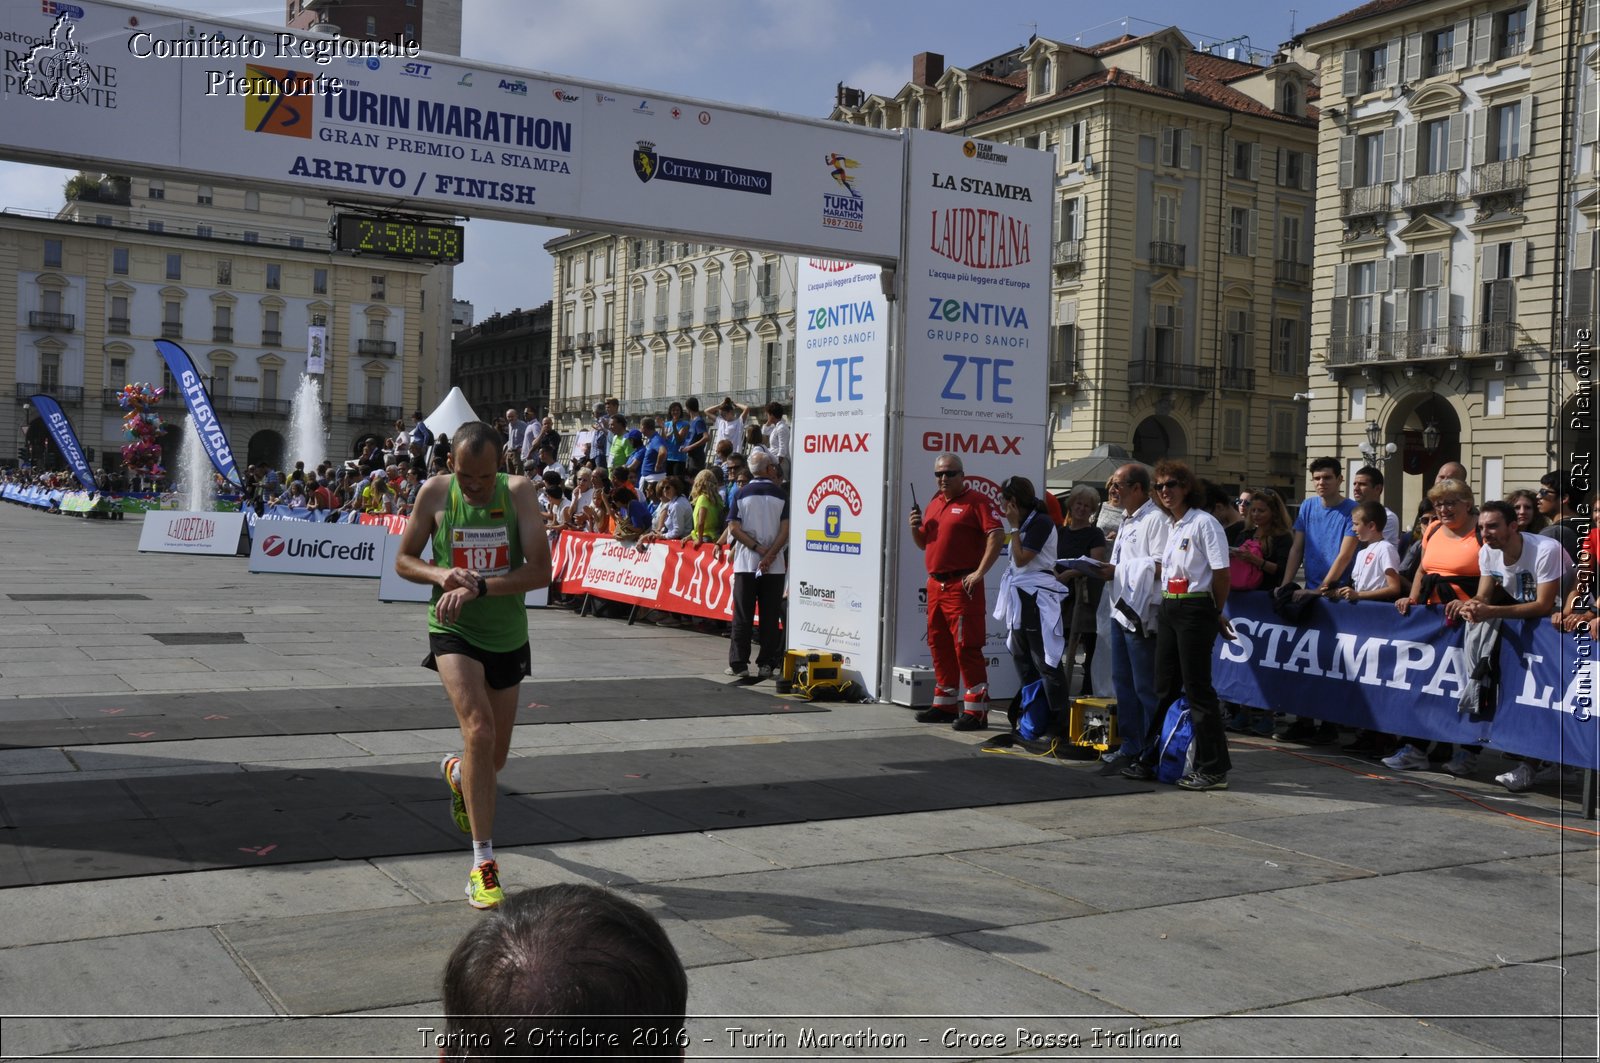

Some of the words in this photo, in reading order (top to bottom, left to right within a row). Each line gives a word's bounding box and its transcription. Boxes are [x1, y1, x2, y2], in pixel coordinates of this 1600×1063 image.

[320, 84, 410, 130] TURIN
[417, 100, 572, 153] MARATHON
[319, 127, 380, 149] GRAN
[386, 136, 465, 160] PREMIO
[471, 148, 495, 165] LA
[501, 152, 571, 174] STAMPA
[976, 143, 994, 153] TEAM
[976, 151, 1008, 163] MARATHON
[288, 156, 406, 188] ARRIVO
[413, 172, 427, 196] /
[434, 174, 536, 205] FINISH
[721, 168, 768, 189] TORINO
[931, 172, 957, 191] LA
[960, 177, 1033, 203] STAMPA
[823, 195, 864, 213] TURIN
[823, 208, 864, 220] MARATHON
[360, 220, 457, 257] 2:50:58
[930, 207, 1031, 269] LAURETANA
[928, 269, 956, 281] L'acqua
[957, 273, 969, 282] più
[970, 274, 998, 285] leggera
[998, 279, 1031, 290] d'Europa
[806, 336, 839, 350] GRUPPO
[843, 331, 876, 345] SANOFI
[927, 329, 979, 344] GRUPPO
[985, 335, 1029, 349] SANOFI
[815, 356, 865, 403] ZTE
[941, 354, 1014, 404] ZTE
[940, 407, 974, 417] Tomorrow
[975, 411, 994, 419] never
[996, 412, 1014, 420] waits
[803, 432, 869, 454] GIMAX
[922, 431, 1022, 456] GIMAX
[808, 478, 861, 513] TAPPOROSSO
[167, 517, 216, 541] LAURETANA
[287, 538, 375, 561] UniCredit
[463, 548, 497, 569] 187
[601, 542, 636, 564] L'acqua
[587, 567, 615, 584] leggera
[616, 568, 658, 592] d'Europa
[799, 581, 836, 599] Tailorsan
[800, 621, 861, 646] Mirafiori
[1219, 617, 1467, 699] STAMPA
